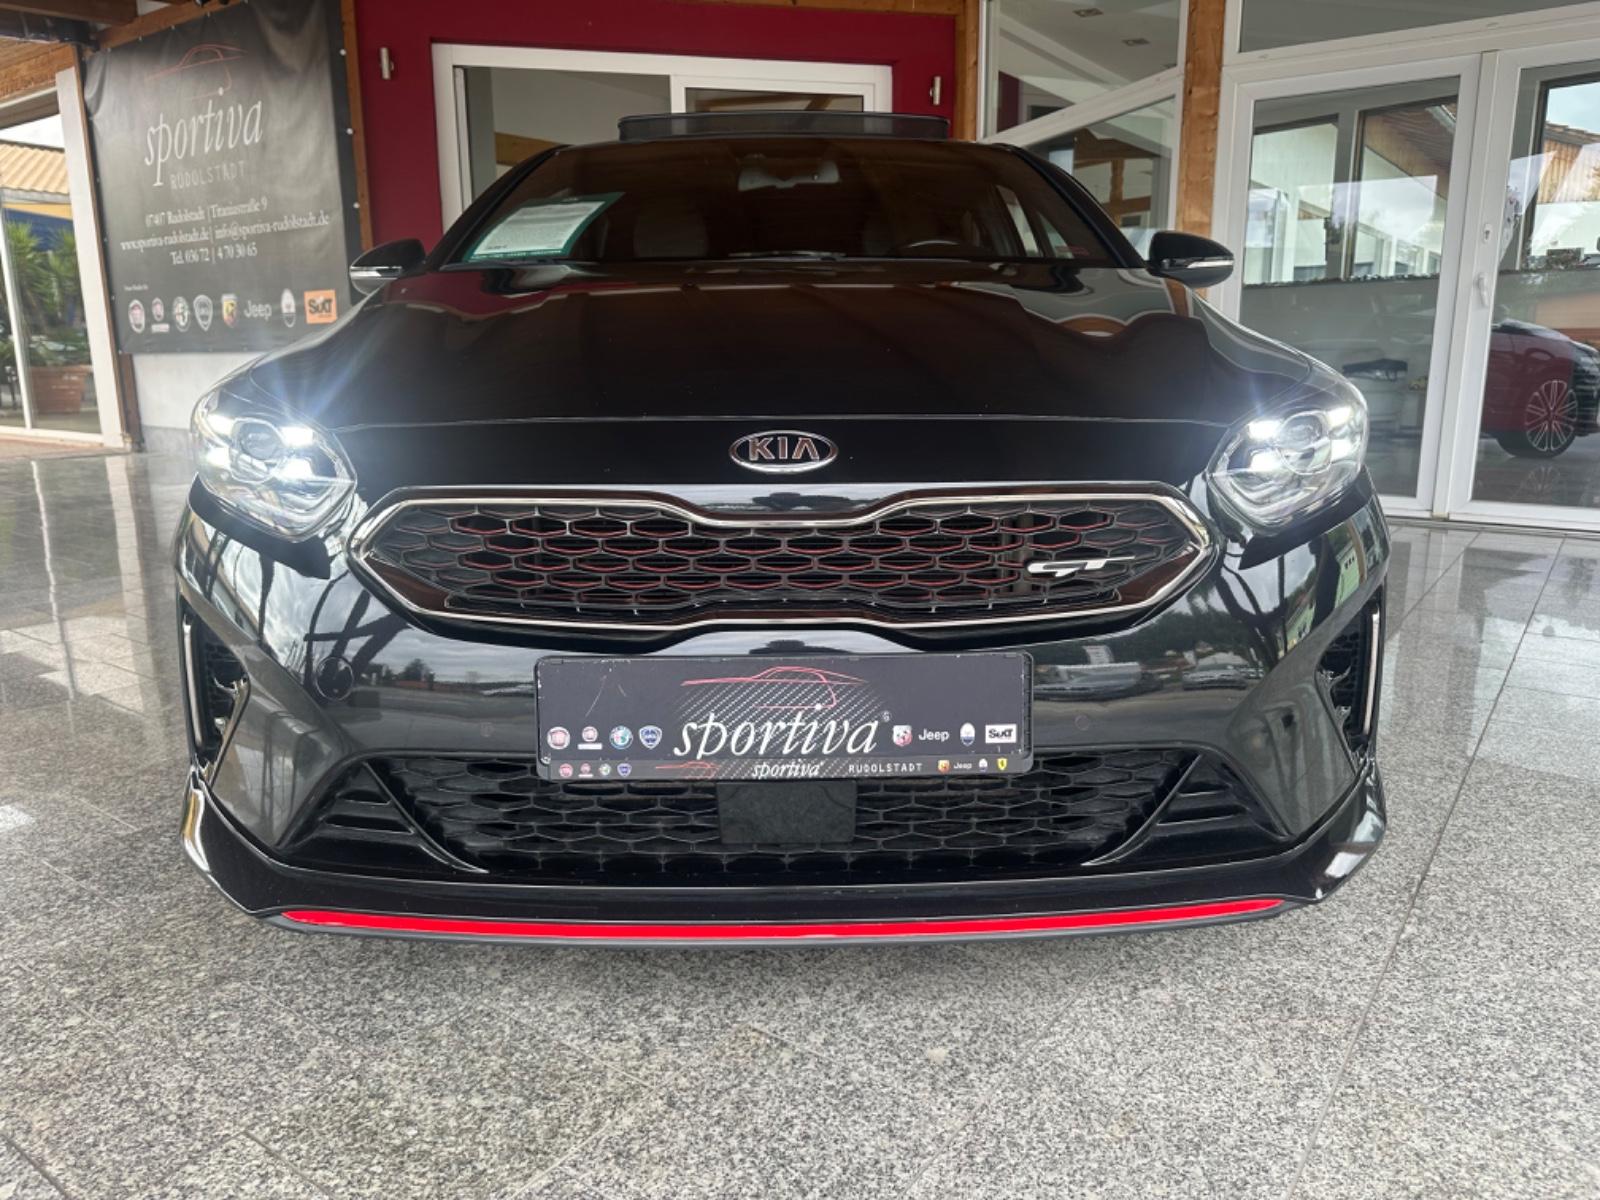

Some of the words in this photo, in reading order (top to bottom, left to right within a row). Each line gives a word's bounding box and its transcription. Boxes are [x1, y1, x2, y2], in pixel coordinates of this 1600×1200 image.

[144, 87, 263, 187] sportiva
[170, 160, 245, 190] RUDOLSTADT
[243, 300, 272, 321] Jeep
[748, 436, 820, 461] KIA
[1027, 556, 1136, 577] GT
[673, 703, 880, 760] sportiva
[918, 728, 949, 742] Jeep
[849, 762, 923, 773] RUDOLSTADT
[953, 762, 972, 770] Jeep
